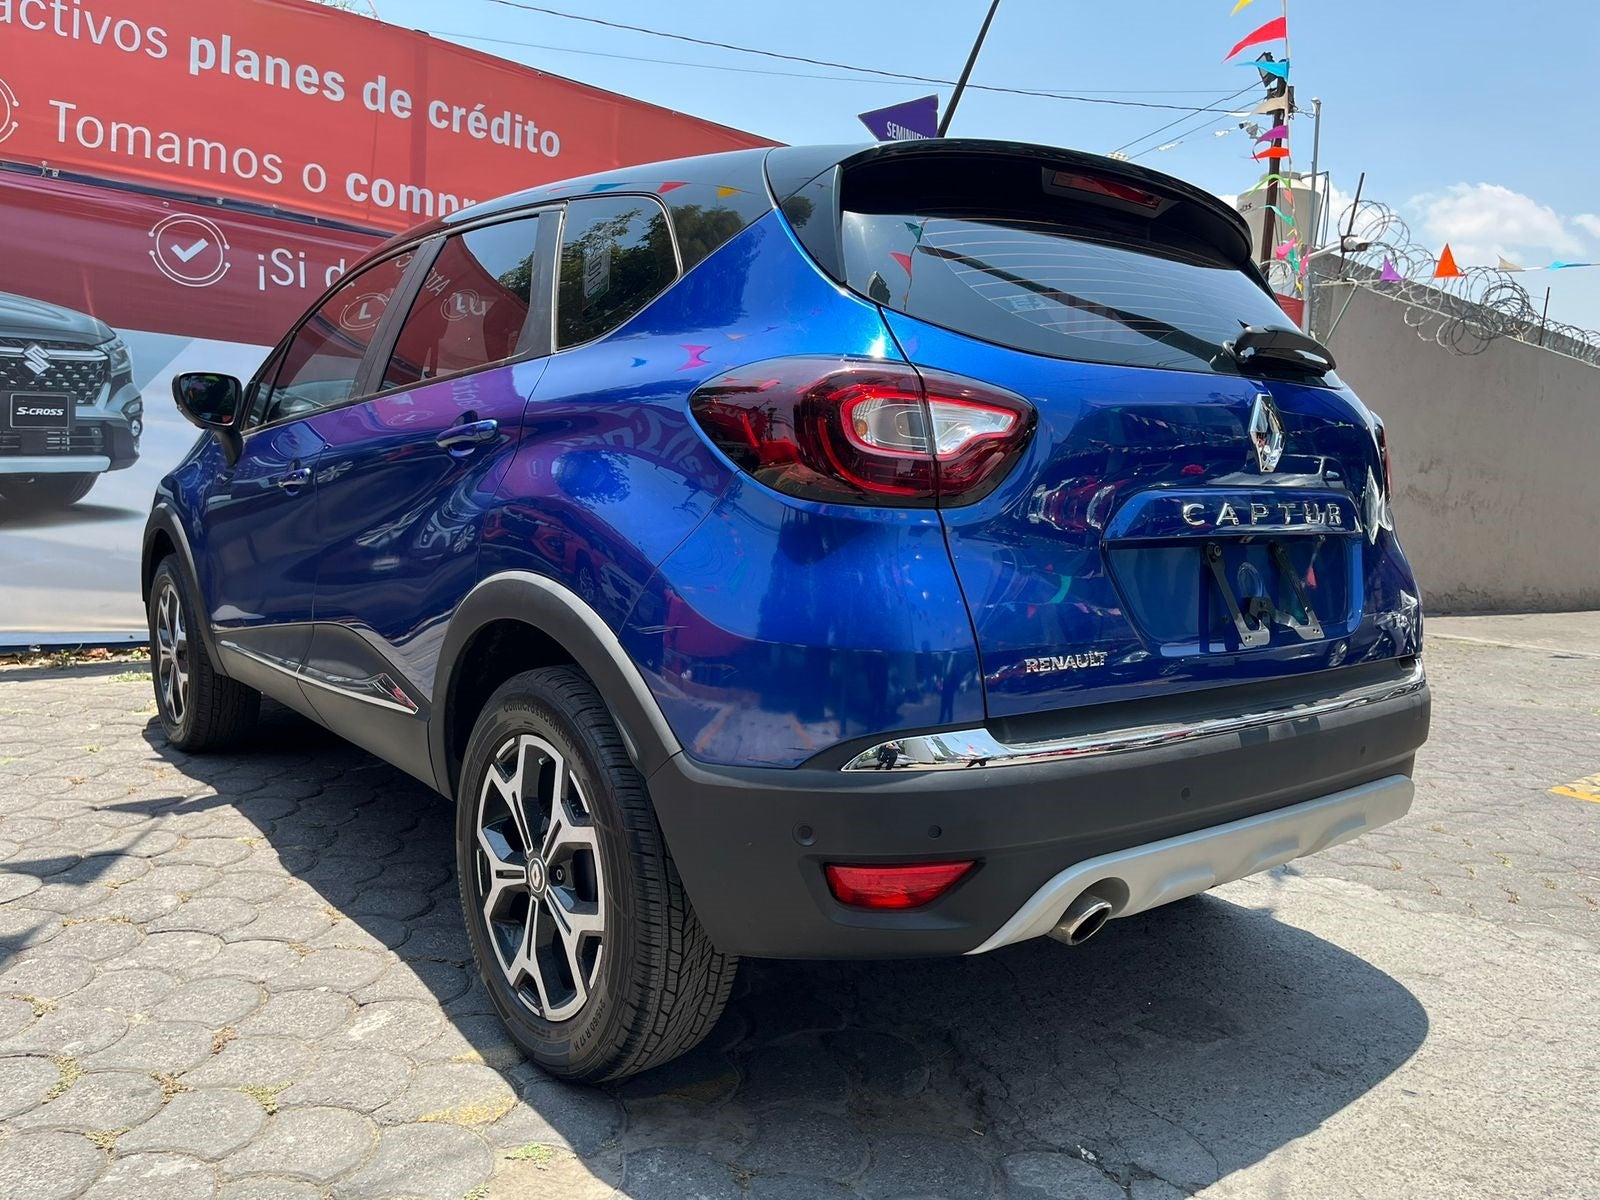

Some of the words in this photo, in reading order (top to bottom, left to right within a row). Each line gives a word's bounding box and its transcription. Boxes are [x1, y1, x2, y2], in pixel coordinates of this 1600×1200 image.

[189, 34, 345, 102] planes
[363, 75, 412, 119] de
[428, 99, 560, 158] crédito
[49, 99, 283, 185] Tomamos
[302, 163, 327, 193] o
[257, 248, 305, 291] ¡Si
[1182, 503, 1342, 526] CAPTUR
[1024, 650, 1108, 673] RENAULT
